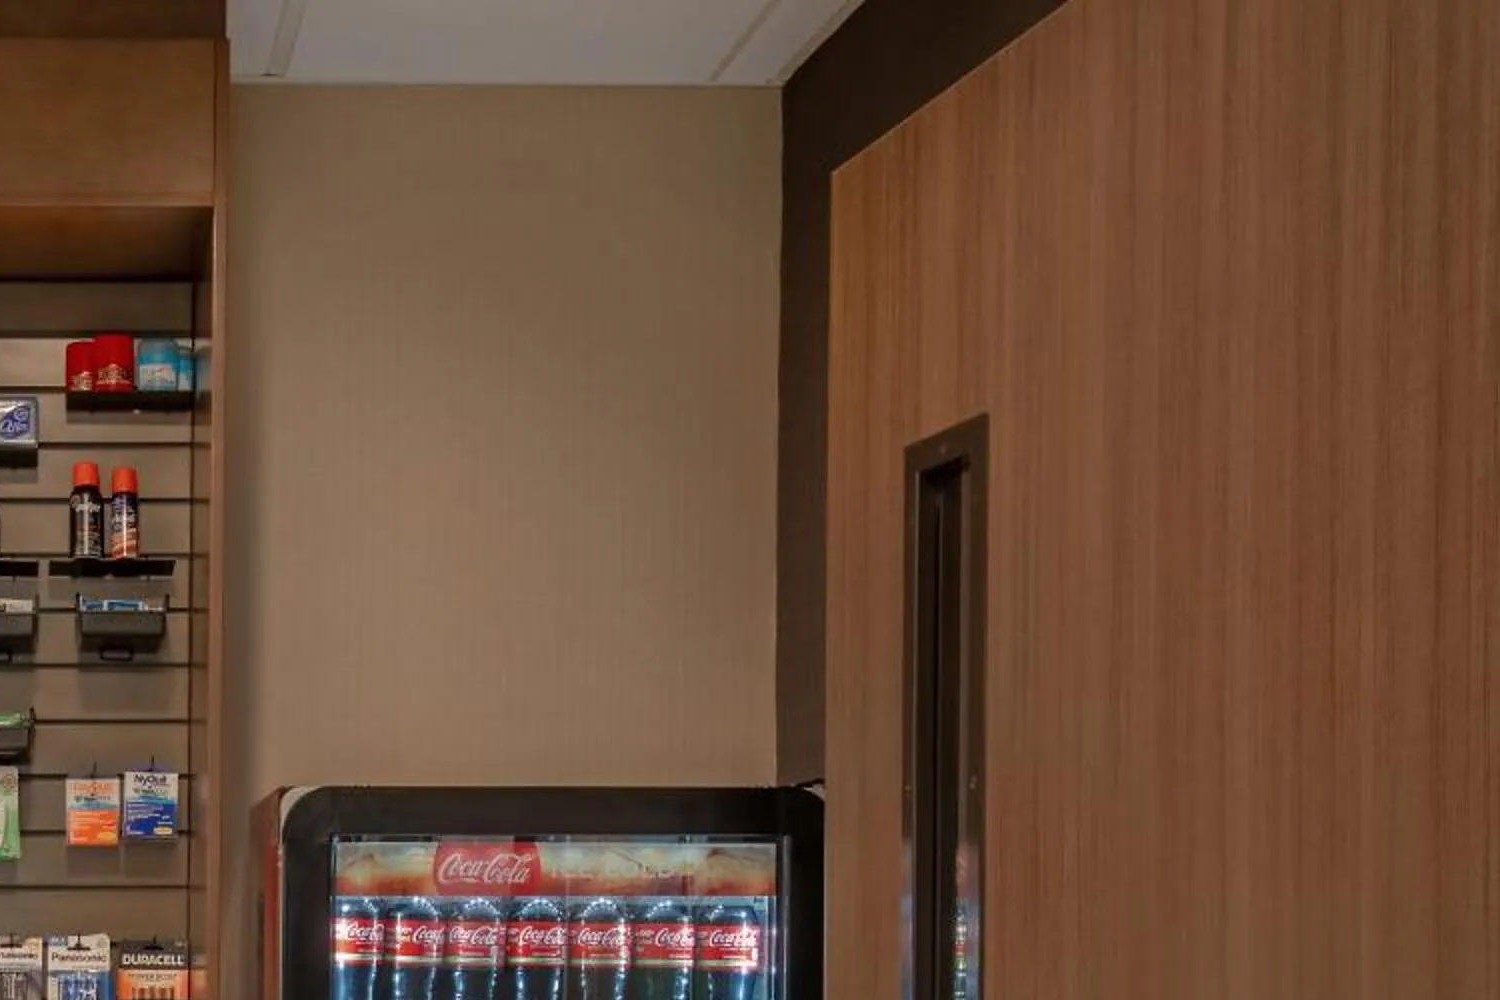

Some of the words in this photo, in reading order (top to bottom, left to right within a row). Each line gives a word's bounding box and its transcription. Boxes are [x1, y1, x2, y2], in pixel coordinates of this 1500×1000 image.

[438, 852, 534, 885] Coca-Cola
[51, 952, 107, 964] Panasonic
[121, 952, 185, 967] DURACELL
